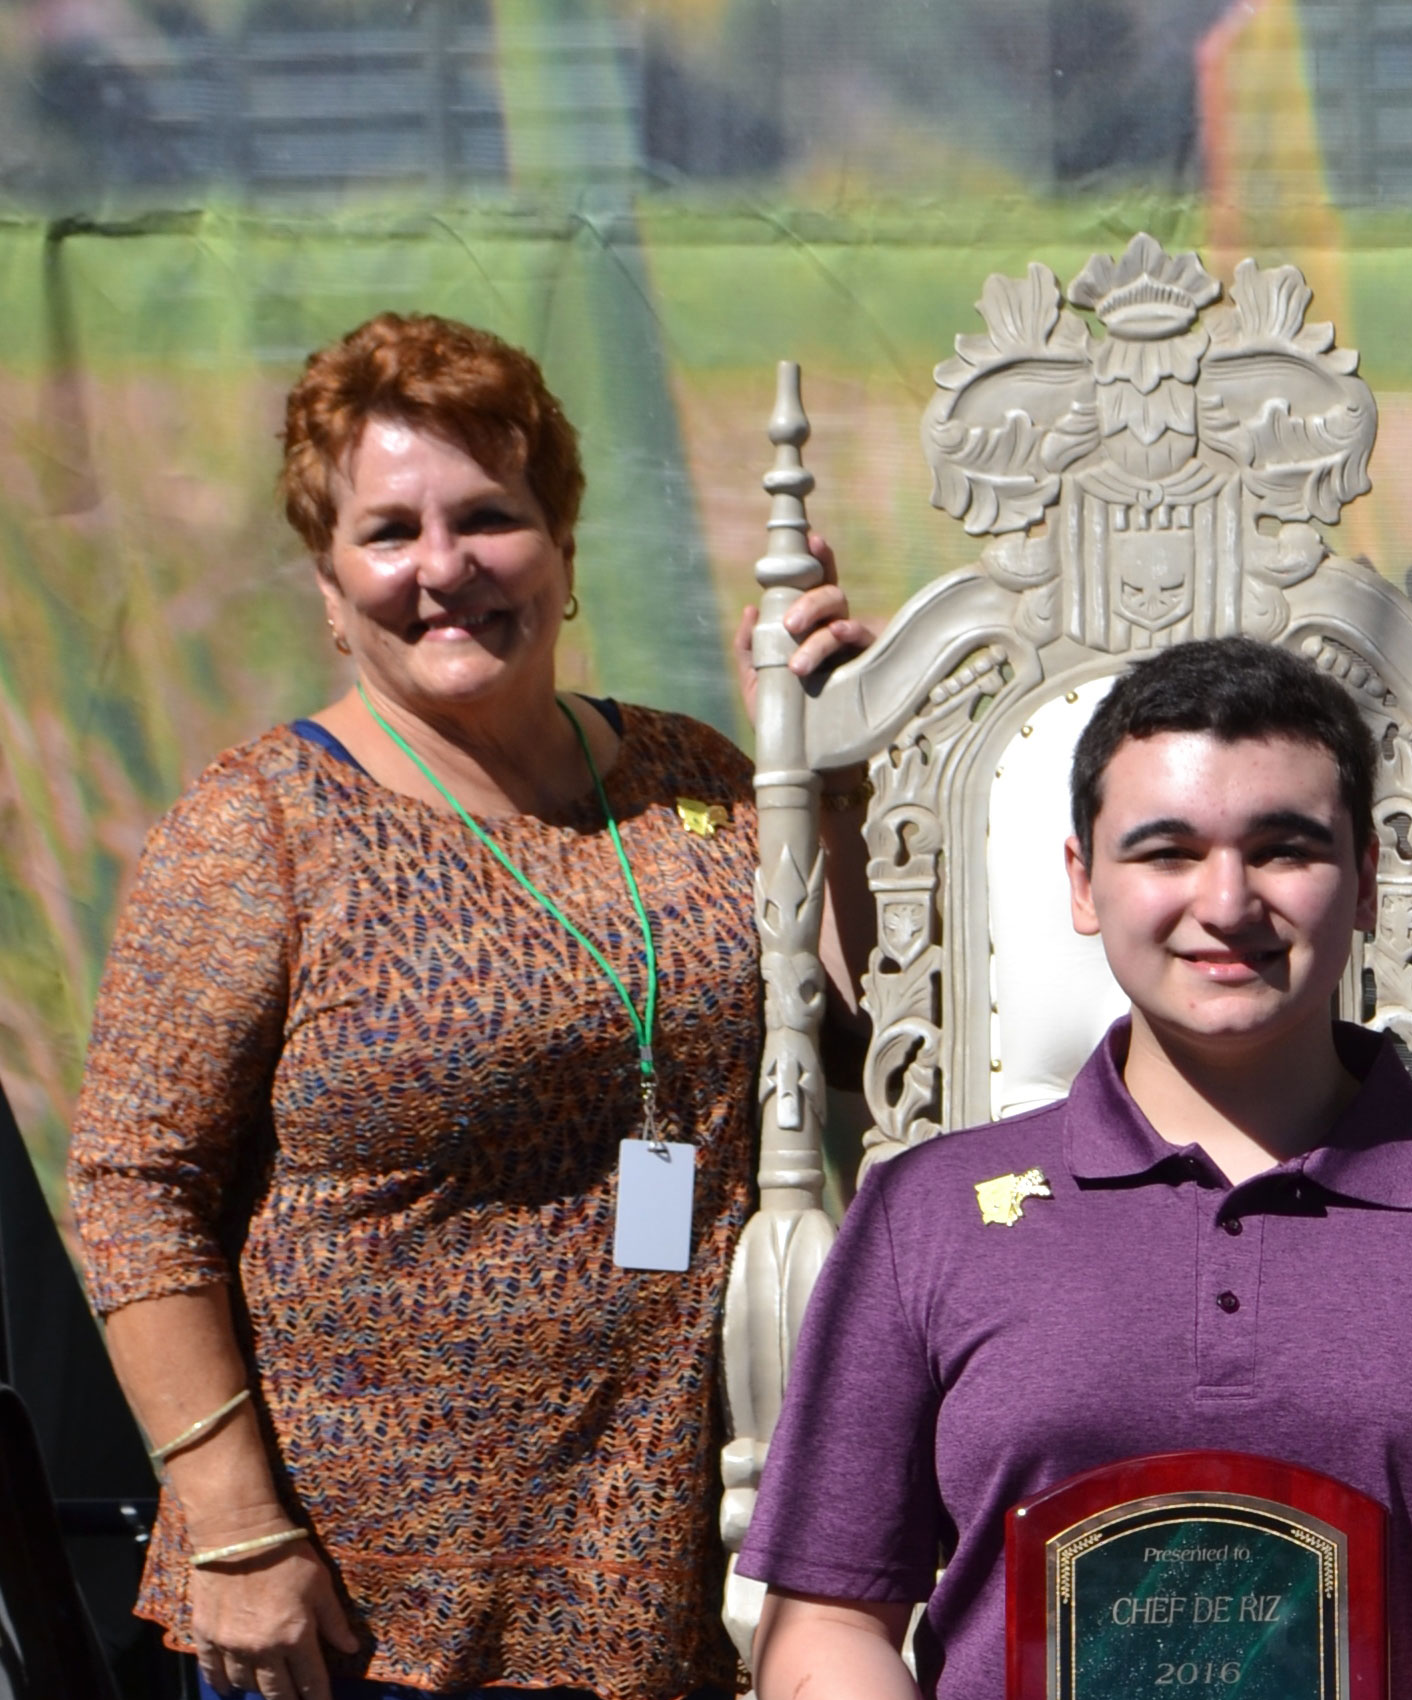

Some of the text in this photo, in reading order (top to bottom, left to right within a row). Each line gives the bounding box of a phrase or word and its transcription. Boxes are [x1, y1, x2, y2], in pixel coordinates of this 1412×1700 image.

[1143, 1545, 1250, 1563] Presented to
[1112, 1596, 1282, 1626] CHEF DE RIZ
[1155, 1662, 1241, 1685] 2016
